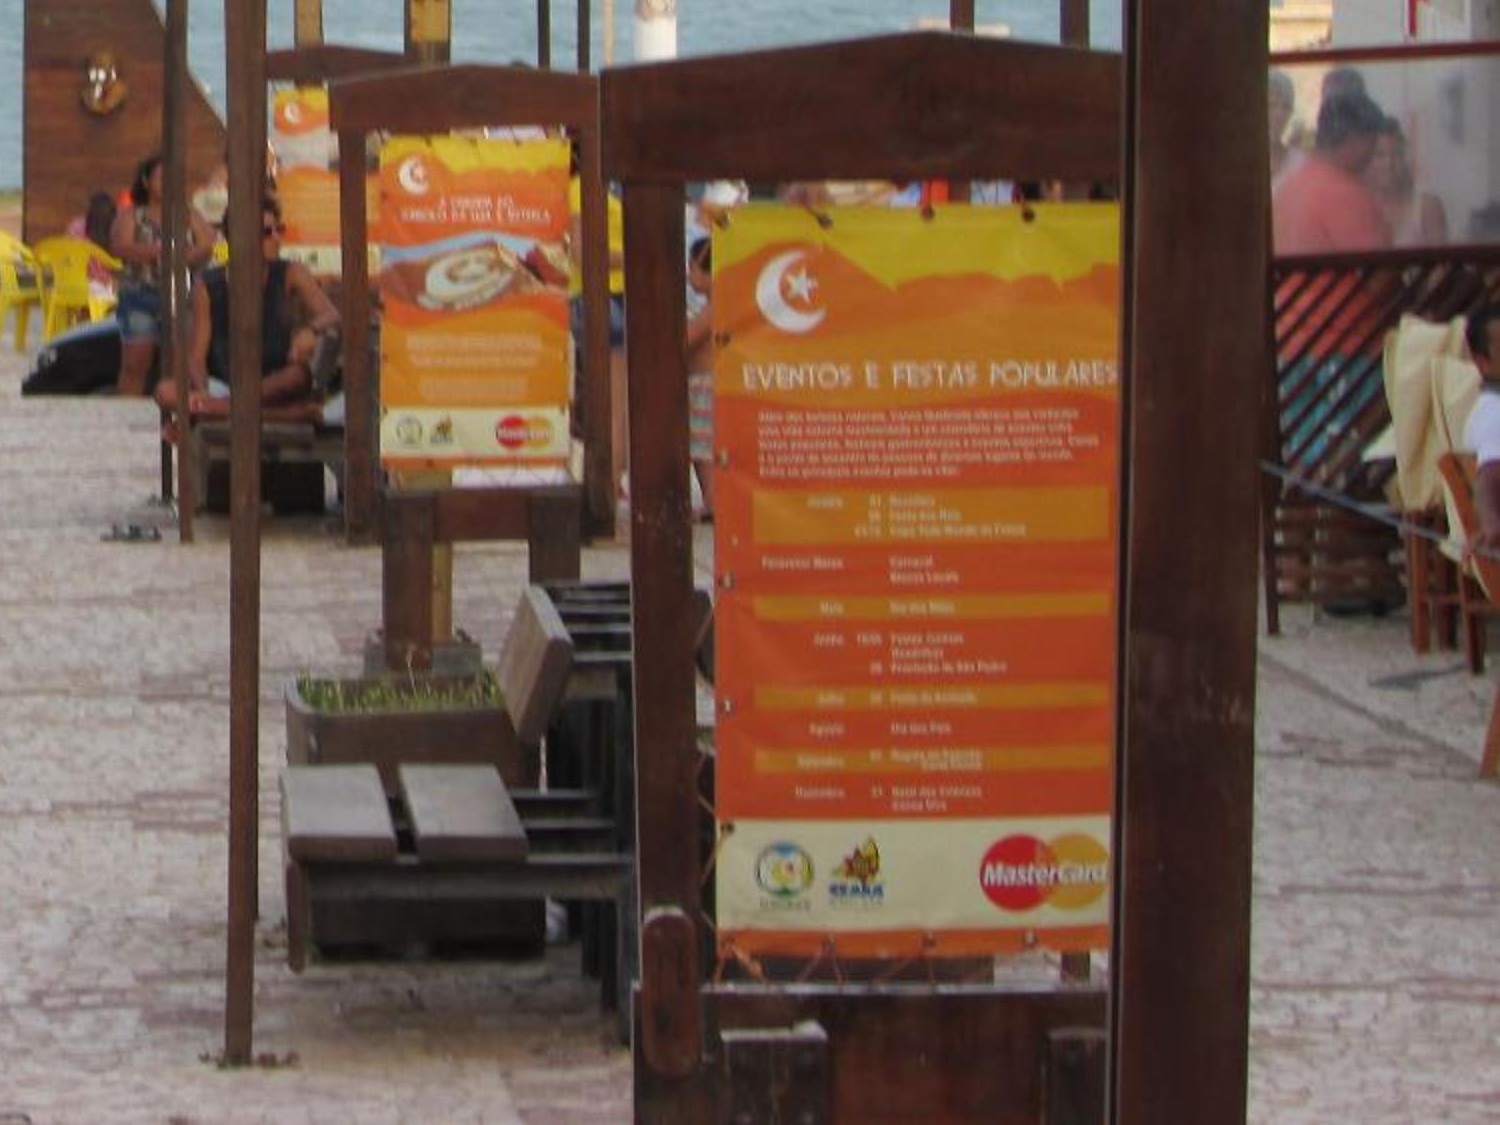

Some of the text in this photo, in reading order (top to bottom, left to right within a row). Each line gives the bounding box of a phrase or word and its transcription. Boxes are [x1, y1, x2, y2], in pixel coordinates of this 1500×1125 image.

[741, 358, 1118, 392] EVENTOS E FESTAS POPULARES
